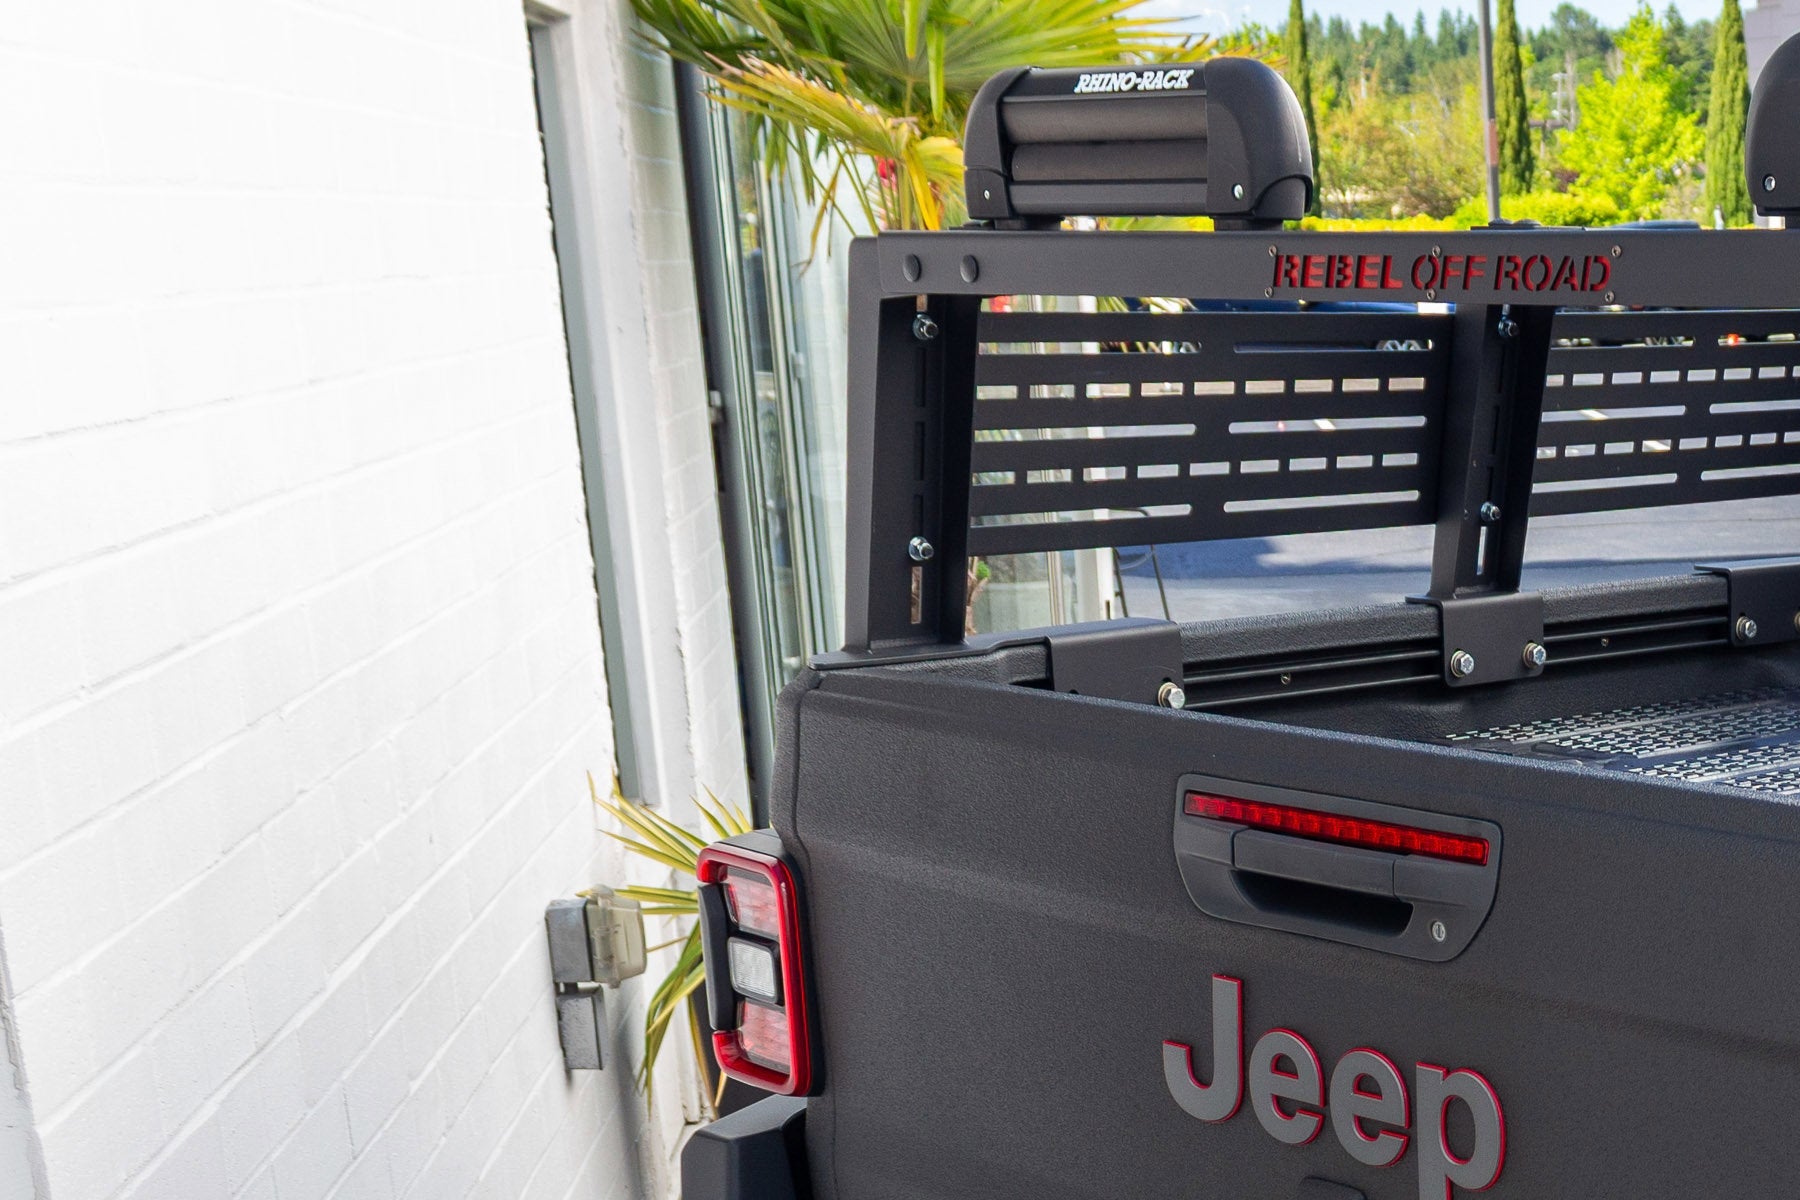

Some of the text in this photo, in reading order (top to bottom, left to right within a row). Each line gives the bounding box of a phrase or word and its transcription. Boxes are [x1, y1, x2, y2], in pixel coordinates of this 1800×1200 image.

[1074, 69, 1194, 94] RHINO-RACK
[1273, 254, 1612, 292] REBEL OFF ROAD
